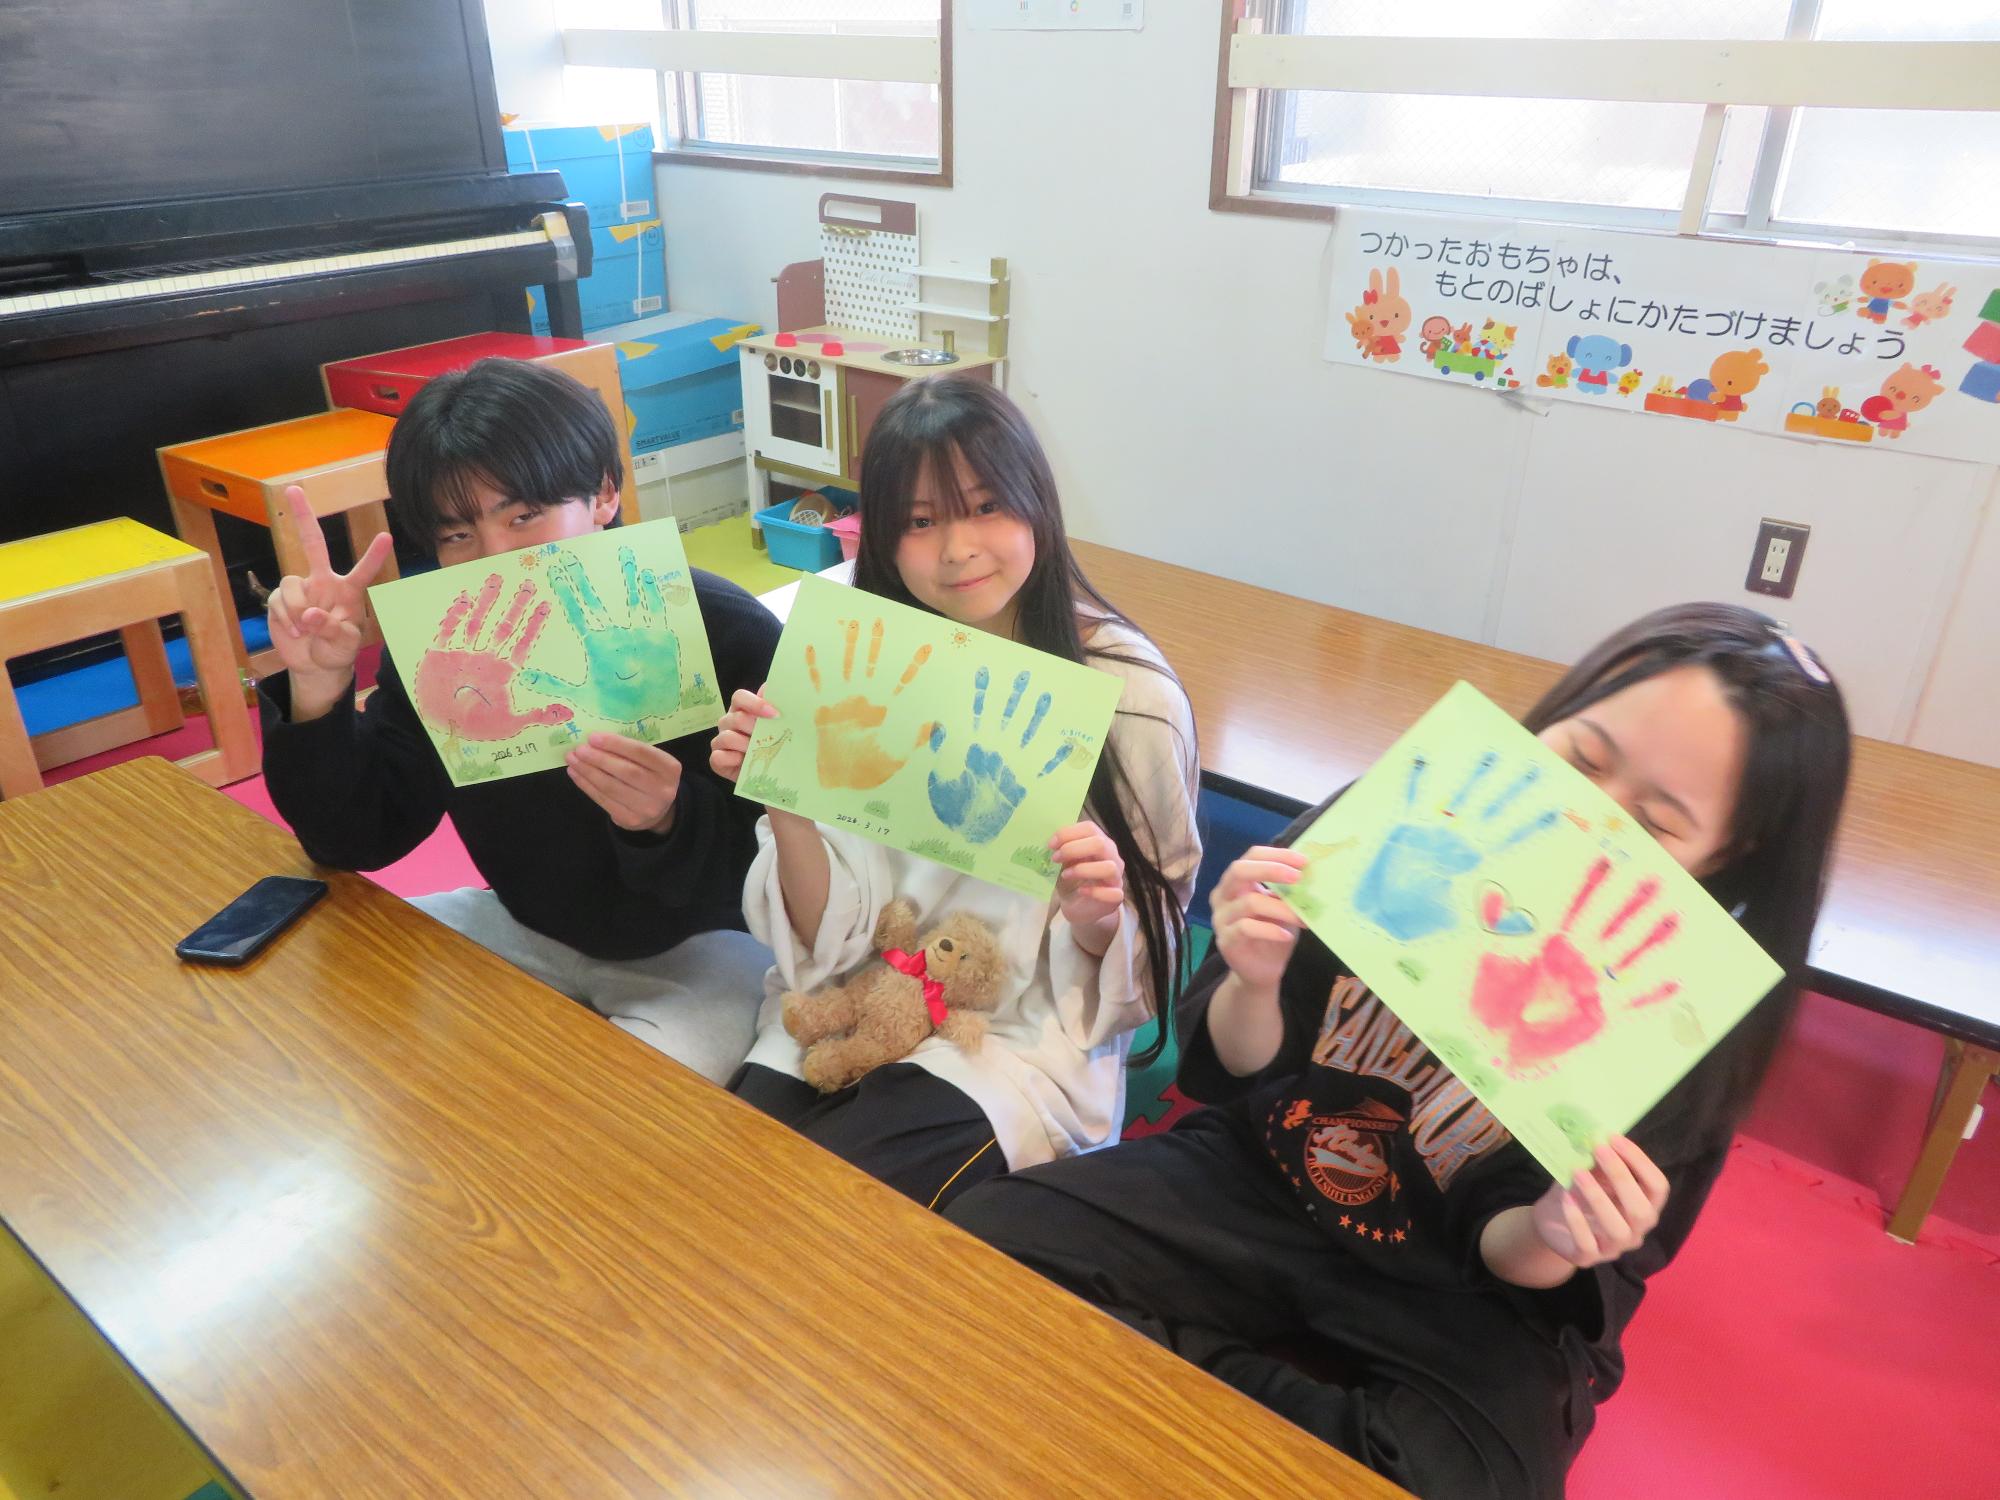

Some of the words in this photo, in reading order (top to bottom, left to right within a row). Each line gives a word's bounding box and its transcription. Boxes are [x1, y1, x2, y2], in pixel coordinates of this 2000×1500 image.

[1360, 231, 1622, 285] つかったおもちゃは、
[1435, 270, 1906, 361] もとのばしょにかたづけましょう
